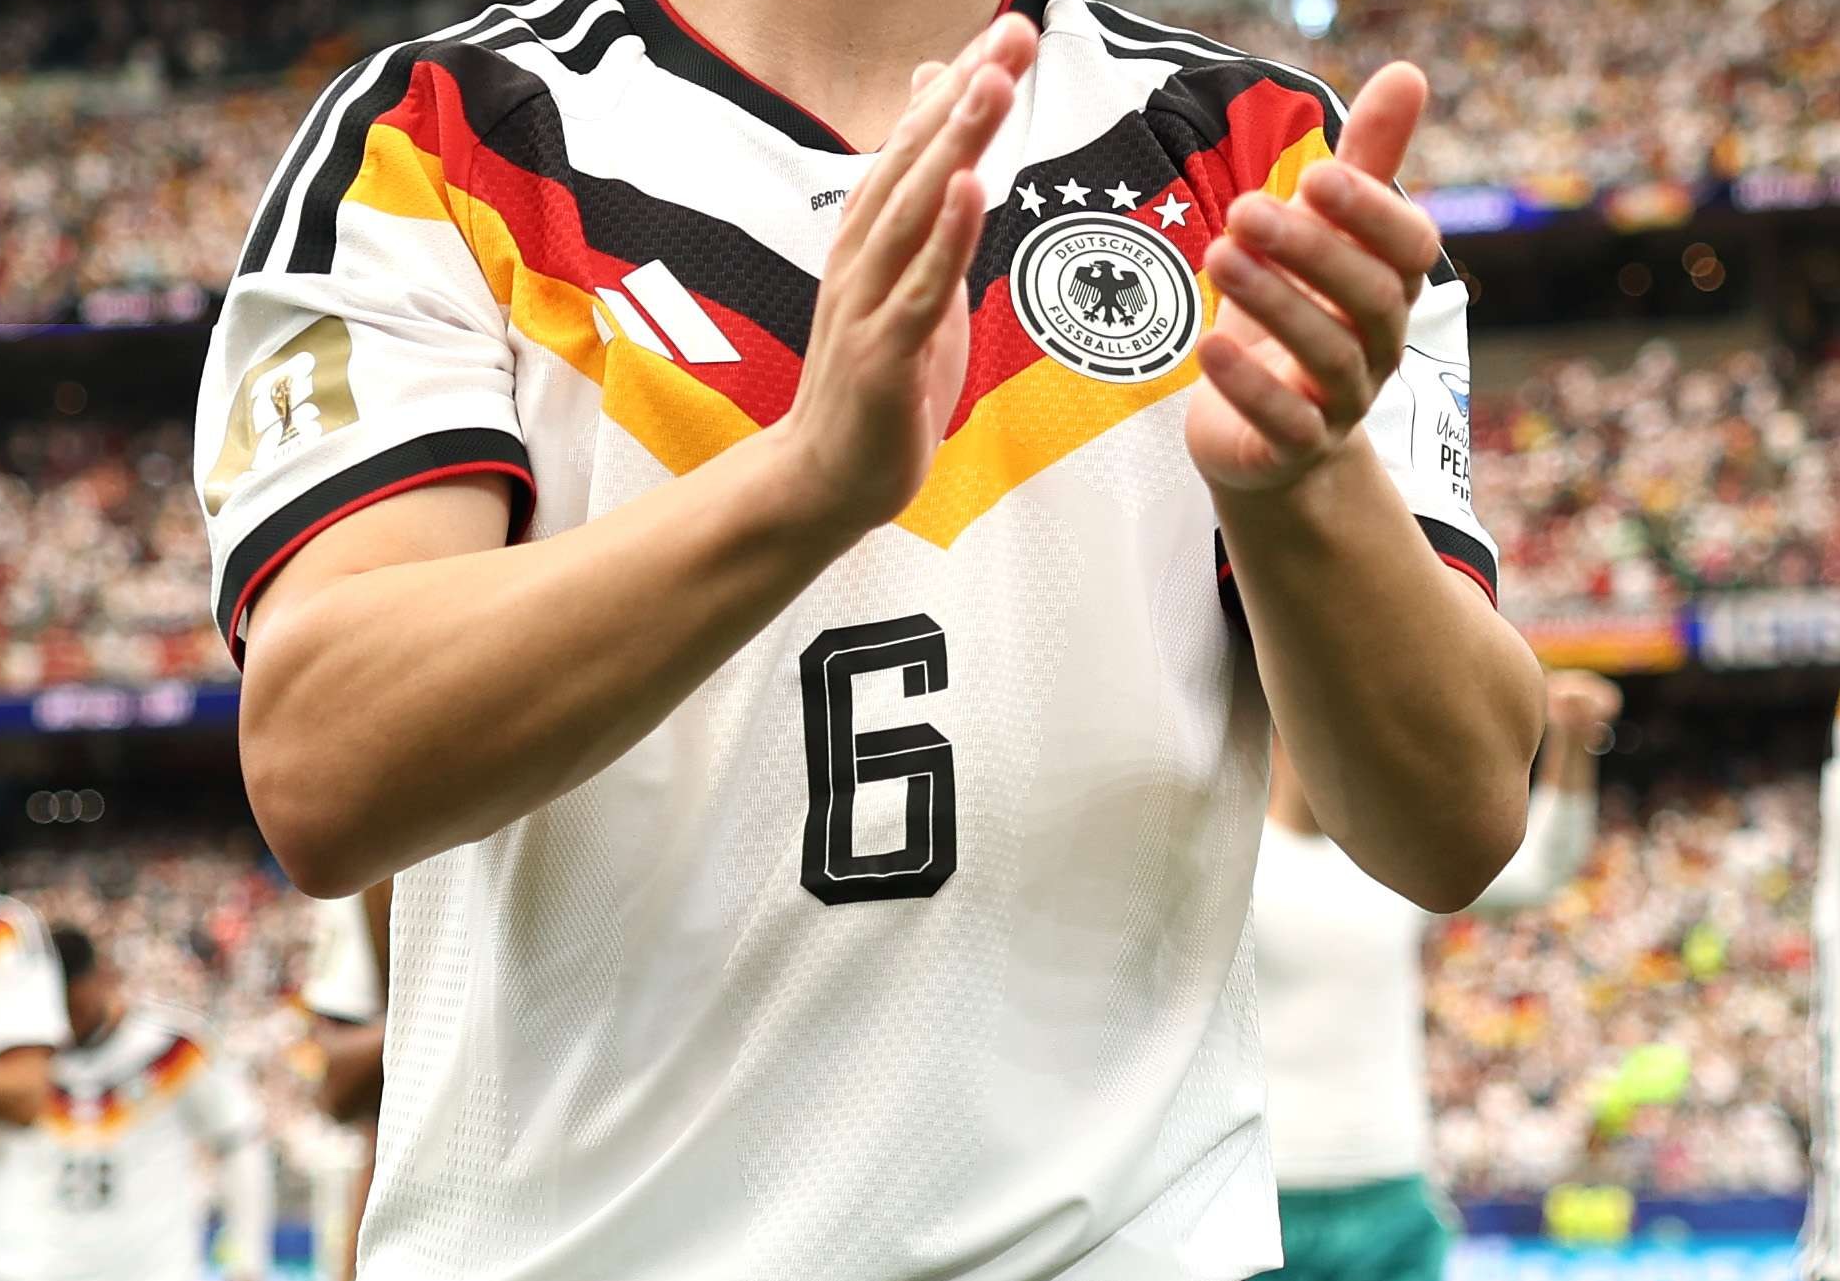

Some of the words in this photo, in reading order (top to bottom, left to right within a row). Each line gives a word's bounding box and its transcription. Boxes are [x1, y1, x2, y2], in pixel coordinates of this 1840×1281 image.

[1054, 236, 1155, 268] DEUTSCHER
[1048, 305, 1169, 354] FUSSBALL-BUND
[799, 613, 957, 906] 6
